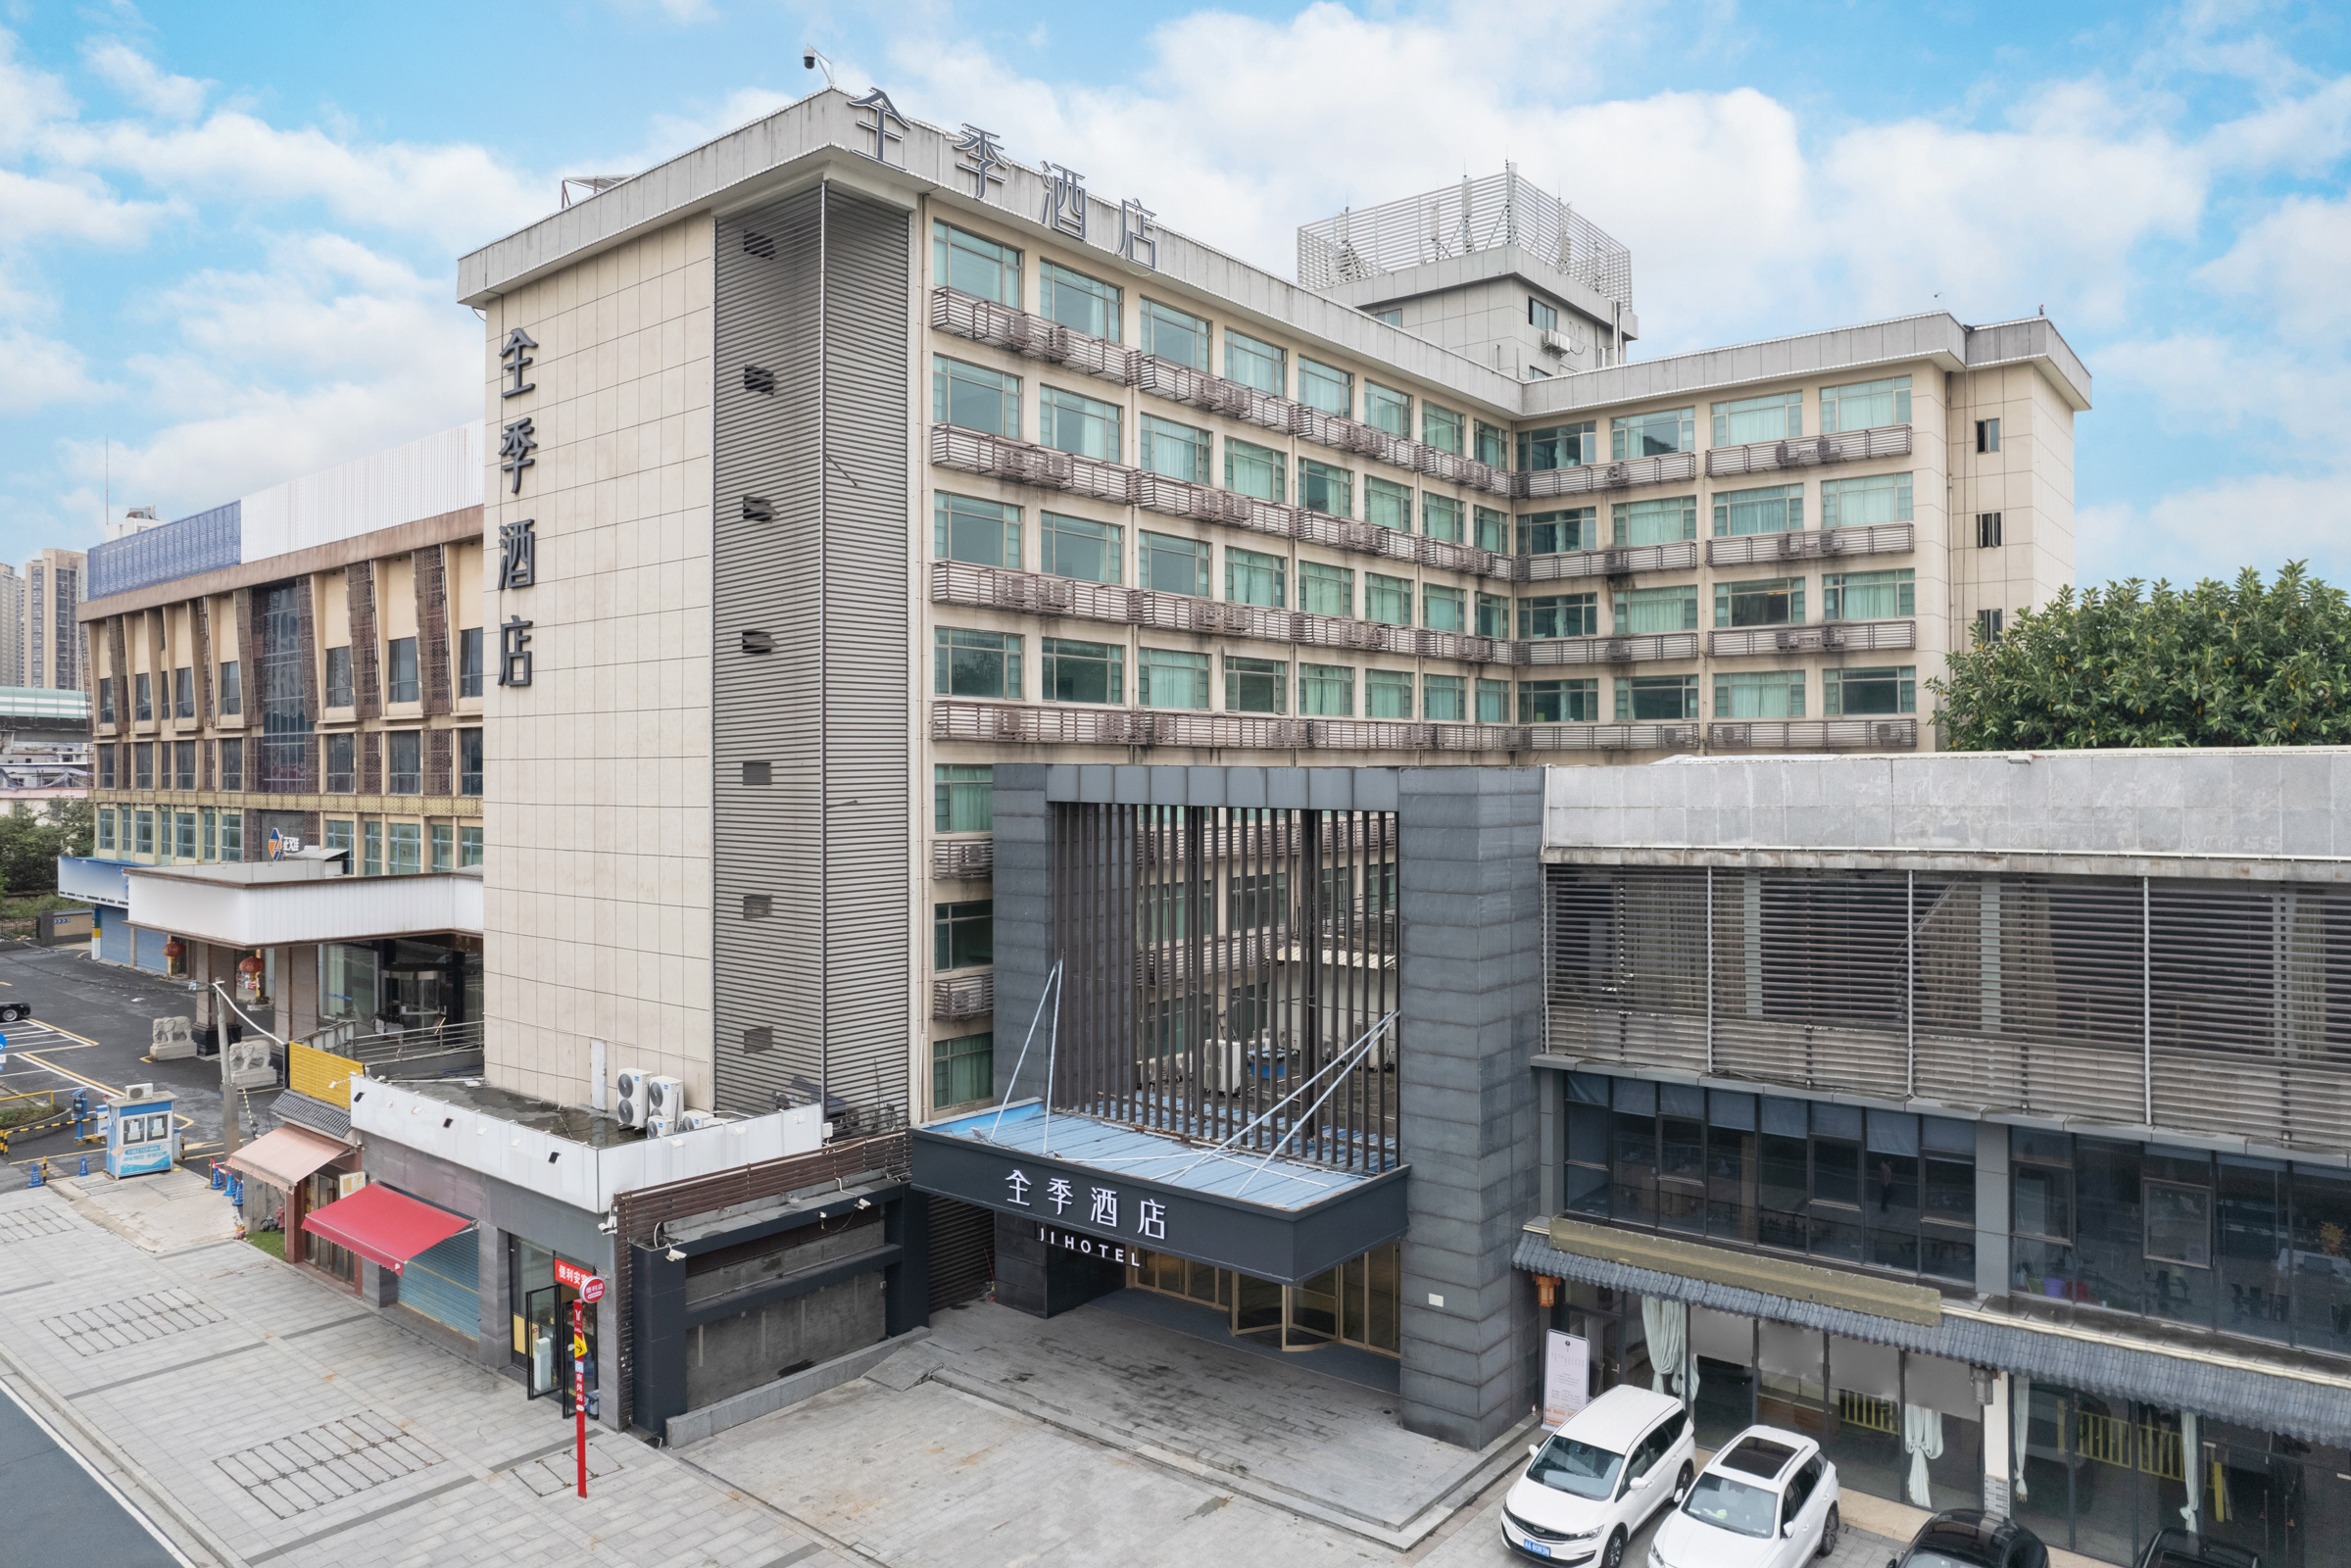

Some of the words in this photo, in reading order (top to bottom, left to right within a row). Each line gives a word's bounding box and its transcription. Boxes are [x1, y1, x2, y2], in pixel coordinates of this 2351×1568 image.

[848, 86, 1157, 271] 全季酒店
[498, 327, 539, 687] 全季酒店
[1004, 1169, 1167, 1241] 全季酒店
[1040, 1227, 1055, 1245] JI
[1064, 1235, 1141, 1267] HOTEL
[585, 1283, 604, 1295] 便利店
